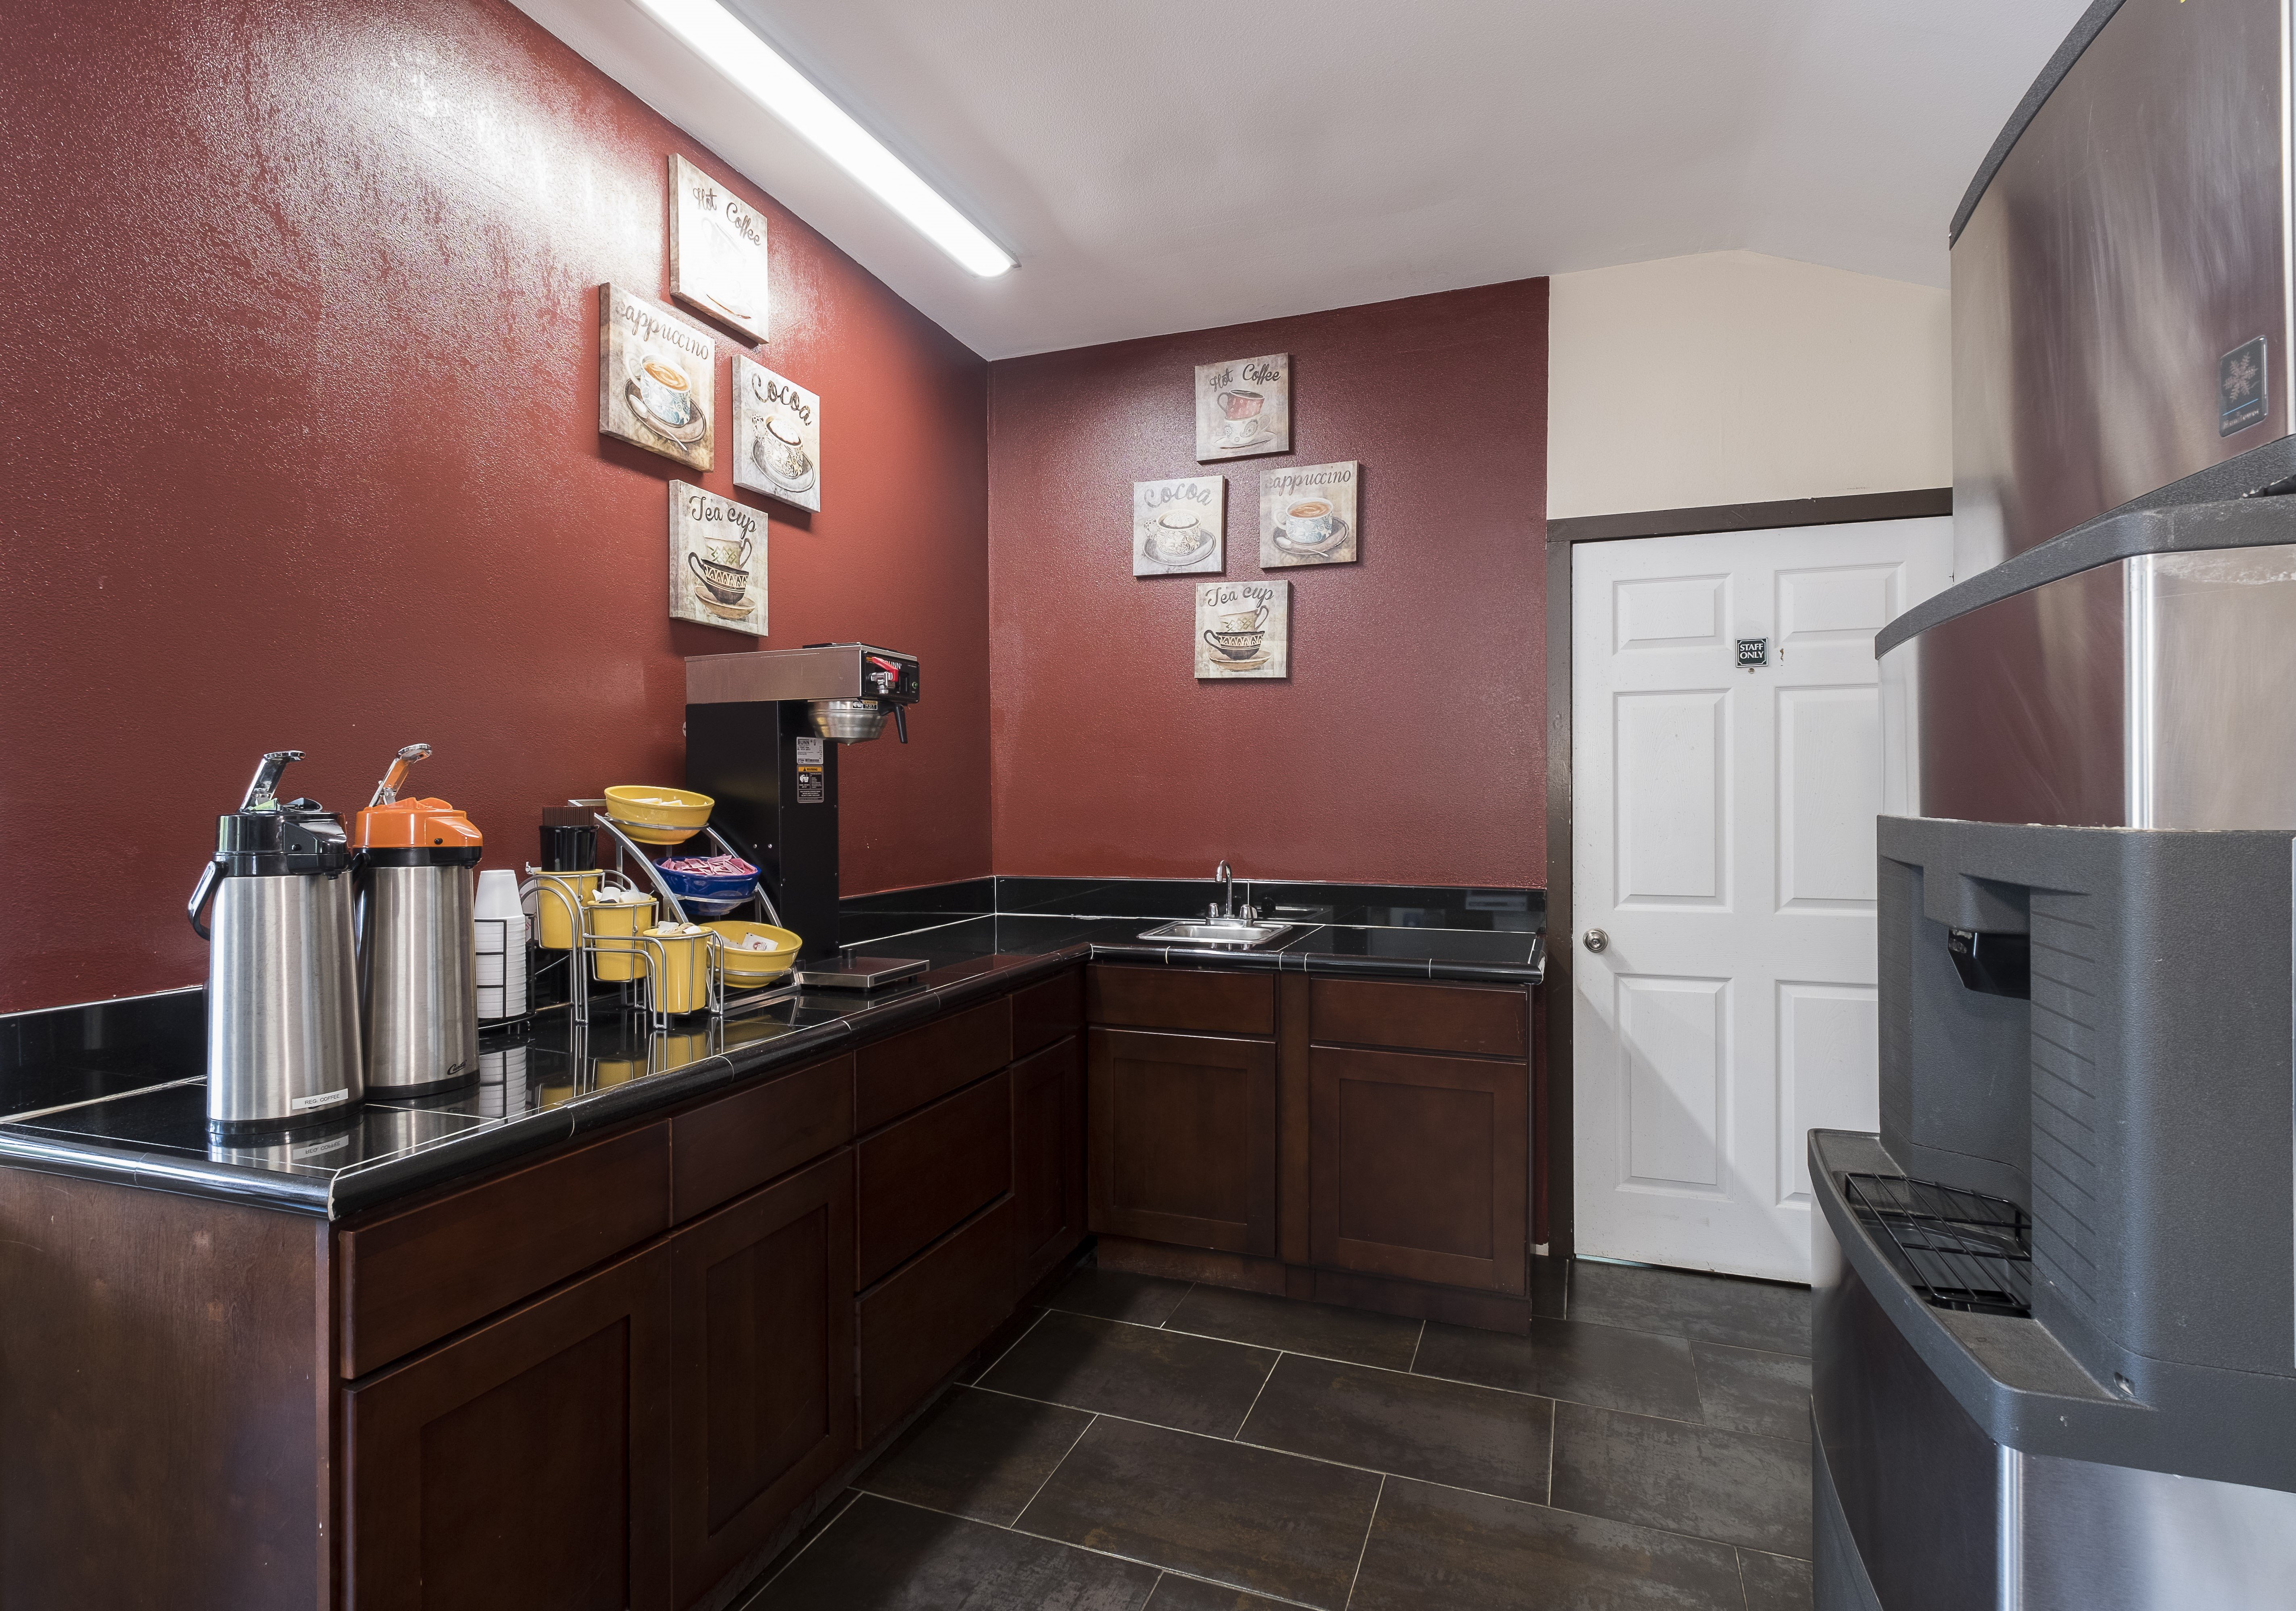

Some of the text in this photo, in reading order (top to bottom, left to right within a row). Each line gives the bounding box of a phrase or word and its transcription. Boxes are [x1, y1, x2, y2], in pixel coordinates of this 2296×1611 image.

[693, 188, 761, 246] Hot Coffee
[1210, 364, 1281, 392] Hot Coffee
[751, 373, 812, 426] Cocoa
[689, 496, 757, 540] Tea cup
[1205, 587, 1274, 608] Tea cup
[1740, 643, 1764, 651] STAFF
[1740, 651, 1764, 659] ONLY
[320, 1094, 340, 1102] COFFEE
